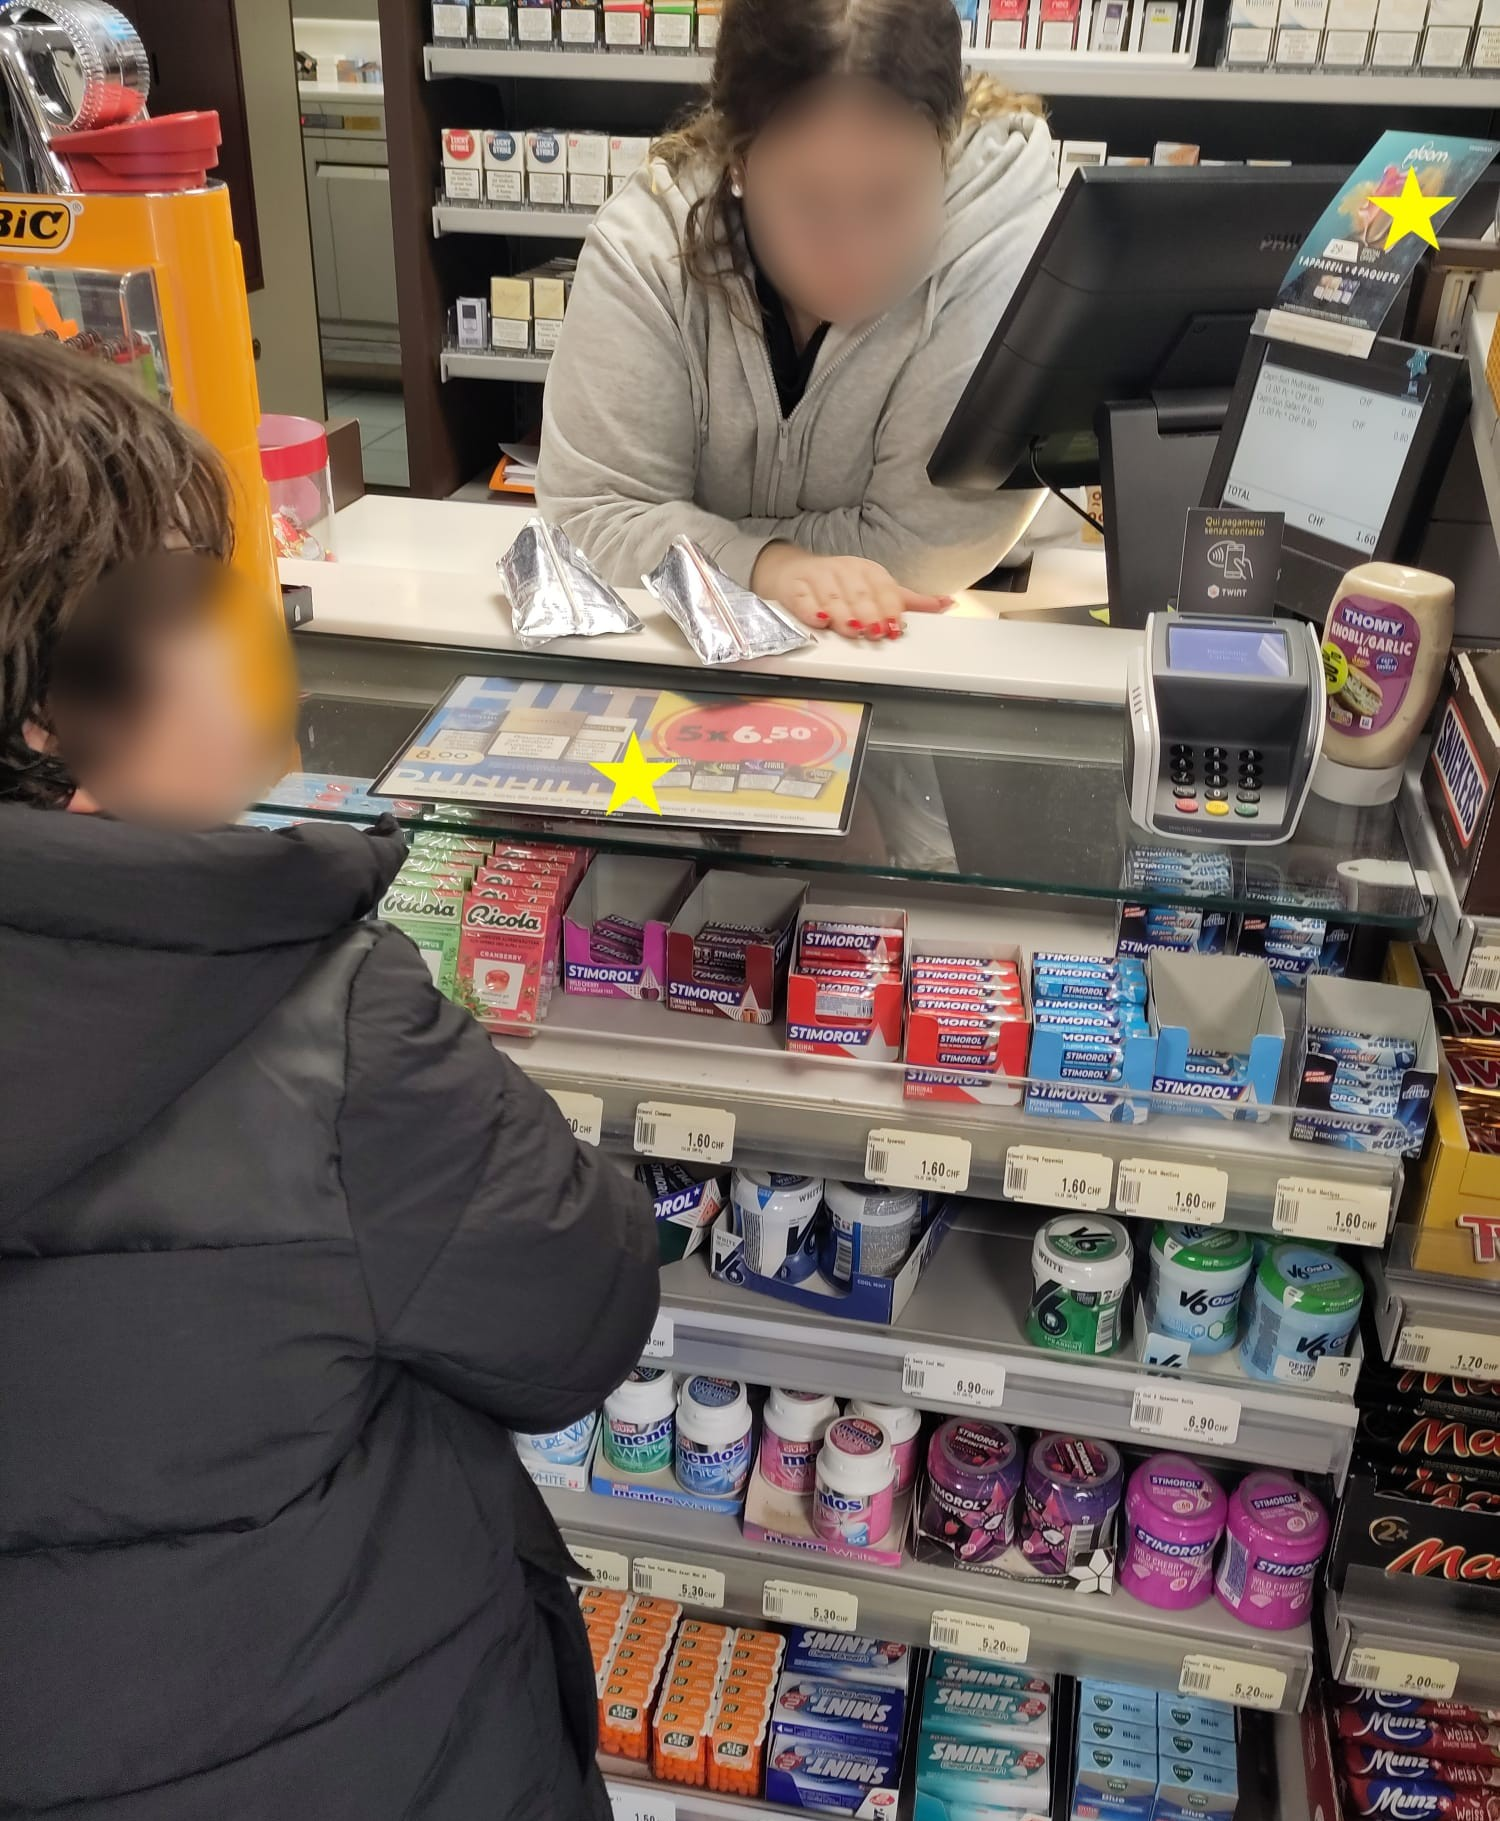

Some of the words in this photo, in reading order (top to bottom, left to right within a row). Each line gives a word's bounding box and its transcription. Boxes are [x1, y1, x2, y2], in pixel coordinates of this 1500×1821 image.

[1302, 256, 1343, 273] APPAREIL
[1358, 268, 1401, 284] PAQUETS
[1228, 484, 1250, 501] TOTAL
[1221, 518, 1266, 530] pagamenti
[1307, 513, 1326, 527] CHF
[1356, 531, 1376, 546] 1.60
[1344, 608, 1402, 636] THOMY
[415, 750, 469, 761] 8.00
[1437, 708, 1484, 836] SNICKERS
[466, 904, 541, 930] Ricola
[805, 933, 871, 949] STIMOROL
[479, 951, 522, 961] CRANBERRY
[915, 956, 984, 967] STIMOROL
[1037, 953, 1107, 964] STIMOROL
[569, 964, 634, 983] STIMOROL
[801, 966, 868, 979] STIMOROL
[917, 970, 984, 982] STIMOROL
[1039, 967, 1109, 980] STIMOROL
[670, 982, 735, 1004] STIMOROL
[917, 985, 985, 997] STIMOROL
[1063, 986, 1107, 996] STIMOROL
[918, 1001, 989, 1013] STIMOROL
[1036, 1000, 1109, 1011] STIMOROL
[1040, 1015, 1112, 1027] STIMOROL
[789, 1025, 861, 1044] STIMOROL
[940, 1035, 982, 1045] STIMOROL
[940, 1054, 982, 1064] STIMOROL
[1066, 1052, 1109, 1062] STIMOROL
[1062, 1068, 1105, 1079] STIMOROL
[1031, 1085, 1107, 1103] STIMOROL
[1153, 1079, 1232, 1100] STIMOROL
[580, 1125, 592, 1134] CHF
[687, 1132, 710, 1149] 1.60
[711, 1140, 725, 1150] CHF
[1372, 1138, 1416, 1150] RUSH
[921, 1160, 945, 1177] 1.60
[946, 1169, 960, 1179] CHF
[1061, 1177, 1087, 1194] 1.60
[1087, 1185, 1102, 1196] CHF
[1175, 1191, 1200, 1208] 1.60
[1201, 1200, 1217, 1210] CHF
[1335, 1210, 1361, 1229] 1.60
[1361, 1221, 1377, 1231] CHF
[716, 1234, 736, 1247] WHITE
[714, 1249, 745, 1284] V6
[1038, 1247, 1063, 1275] WHITE
[1287, 1264, 1309, 1280] V6
[1179, 1289, 1208, 1316] V6
[652, 1339, 664, 1347] CHF
[1296, 1333, 1330, 1360] V6
[1288, 1361, 1316, 1370] DENTA
[1457, 1354, 1483, 1369] 1.70
[1484, 1362, 1498, 1371] CHF
[695, 1379, 739, 1396] mentos
[957, 1380, 981, 1394] 6.90
[981, 1387, 995, 1397] CHF
[613, 1423, 637, 1434] GUM
[852, 1419, 879, 1437] GUM
[1188, 1415, 1214, 1431] 6.90
[1214, 1424, 1229, 1433] CHF
[531, 1432, 564, 1451] PURE
[839, 1423, 880, 1446] mentos
[957, 1427, 1001, 1449] STIMOROL
[678, 1440, 744, 1465] mentos
[783, 1444, 809, 1454] GUM
[1152, 1476, 1198, 1489] STIMOROL
[613, 1488, 673, 1504] mentos
[677, 1498, 725, 1512] White
[1254, 1495, 1295, 1510] STIMOROL
[1377, 1520, 1409, 1542] 2x
[764, 1535, 828, 1552] mentos
[833, 1546, 879, 1562] White
[847, 1536, 866, 1545] 60
[1136, 1529, 1204, 1556] STIMOROL
[1152, 1558, 1184, 1572] CHERRY
[608, 1574, 620, 1582] CHF
[1251, 1575, 1272, 1589] WILD
[1273, 1580, 1304, 1592] CHERRY
[682, 1584, 704, 1597] 5.30
[704, 1592, 716, 1600] CHF
[813, 1607, 836, 1621] 5.30
[836, 1615, 849, 1623] CHF
[798, 1630, 875, 1655] SMINT
[982, 1637, 1006, 1651] 5.20
[1006, 1645, 1019, 1653] CHF
[943, 1666, 1019, 1688] SMINT
[1405, 1674, 1431, 1688] 2.00
[1235, 1683, 1261, 1697] 5.20
[933, 1688, 1014, 1712] SMINT
[1122, 1703, 1141, 1713] Blue
[810, 1696, 892, 1723] SMINT
[1201, 1718, 1219, 1728] Blue
[1352, 1711, 1427, 1740] Munz
[1122, 1731, 1141, 1741] Blue
[1444, 1727, 1475, 1742] Weiss
[928, 1742, 1011, 1766] SMINT
[1202, 1746, 1222, 1756] Blue
[807, 1757, 889, 1785] SMINT
[1122, 1759, 1141, 1769] Blue
[1357, 1749, 1430, 1778] Munz
[1203, 1774, 1223, 1784] Blue
[1448, 1766, 1477, 1782] Weiss
[1101, 1793, 1125, 1804] Blue
[1360, 1786, 1438, 1820] Munz
[1455, 1806, 1485, 1821] Weiss
